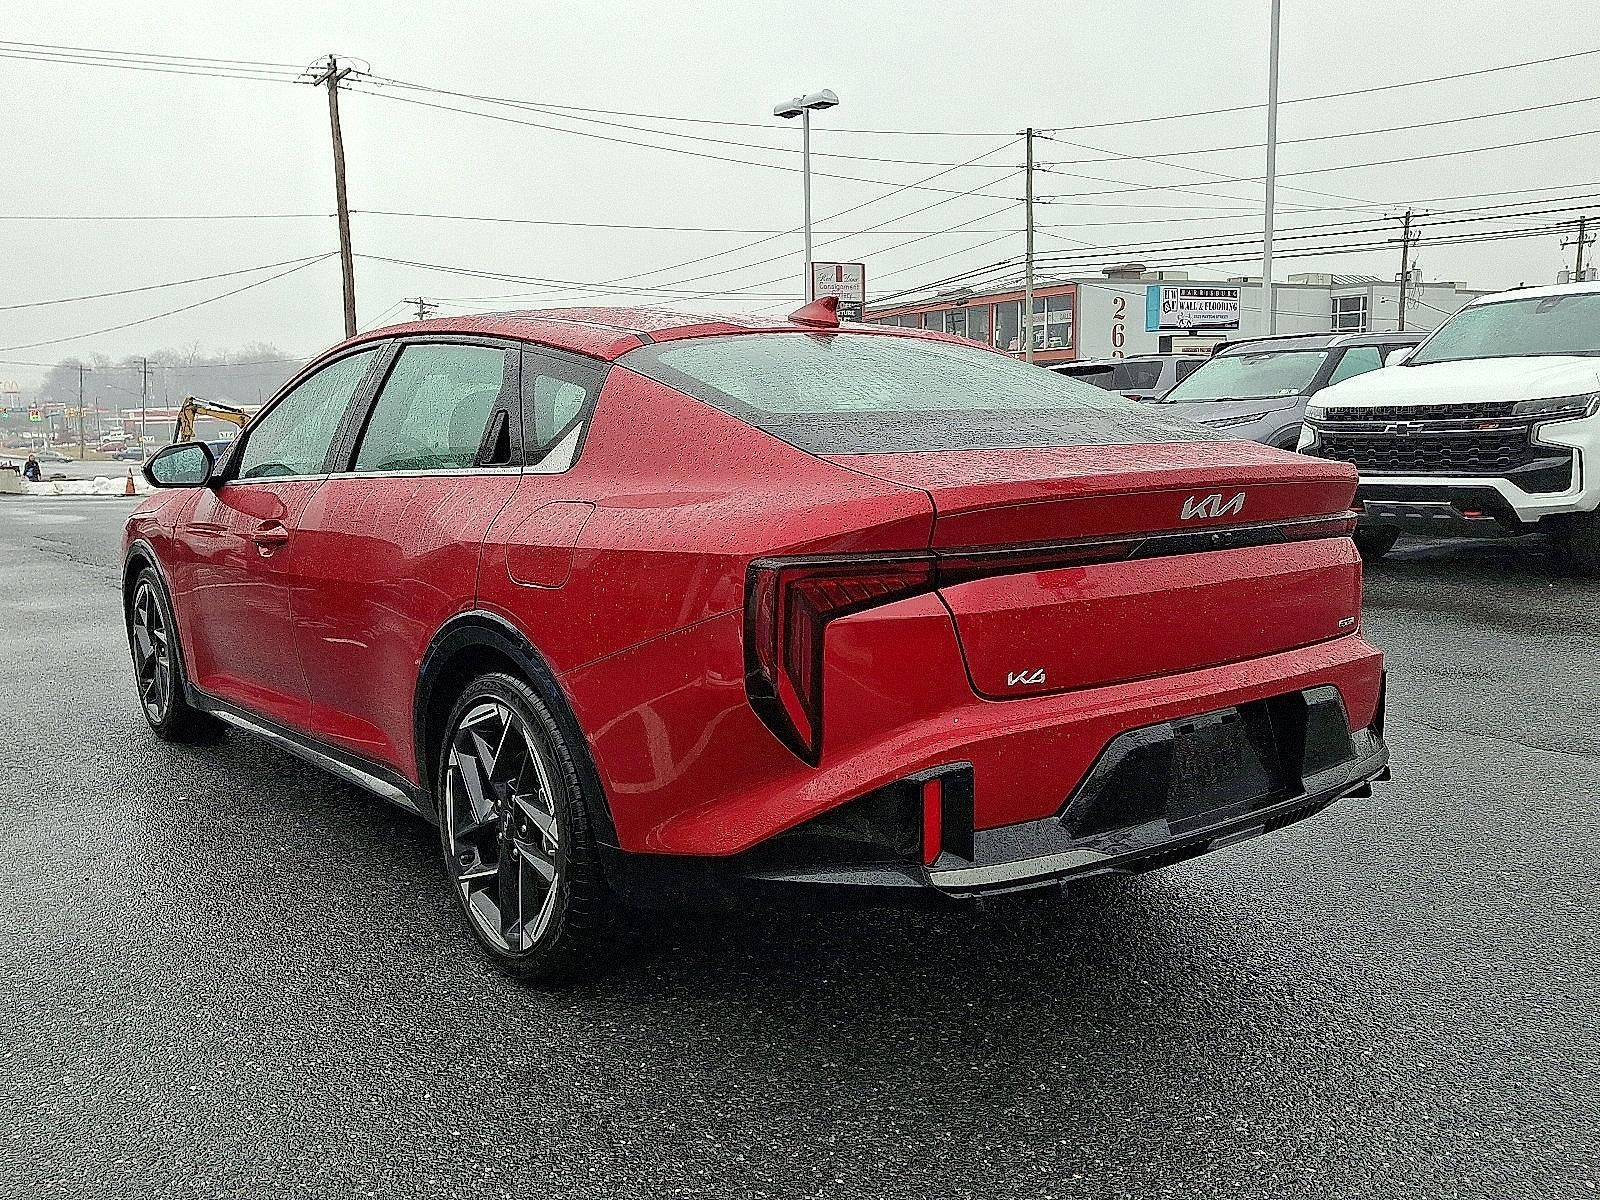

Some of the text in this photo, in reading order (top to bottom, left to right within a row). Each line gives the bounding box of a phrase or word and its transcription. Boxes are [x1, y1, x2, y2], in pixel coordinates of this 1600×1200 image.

[1180, 289, 1237, 298] HARRISBURG
[1179, 301, 1198, 311] WALL
[1204, 301, 1238, 311] FLOORING
[1180, 492, 1246, 520] KIA
[1007, 668, 1046, 686] K4
